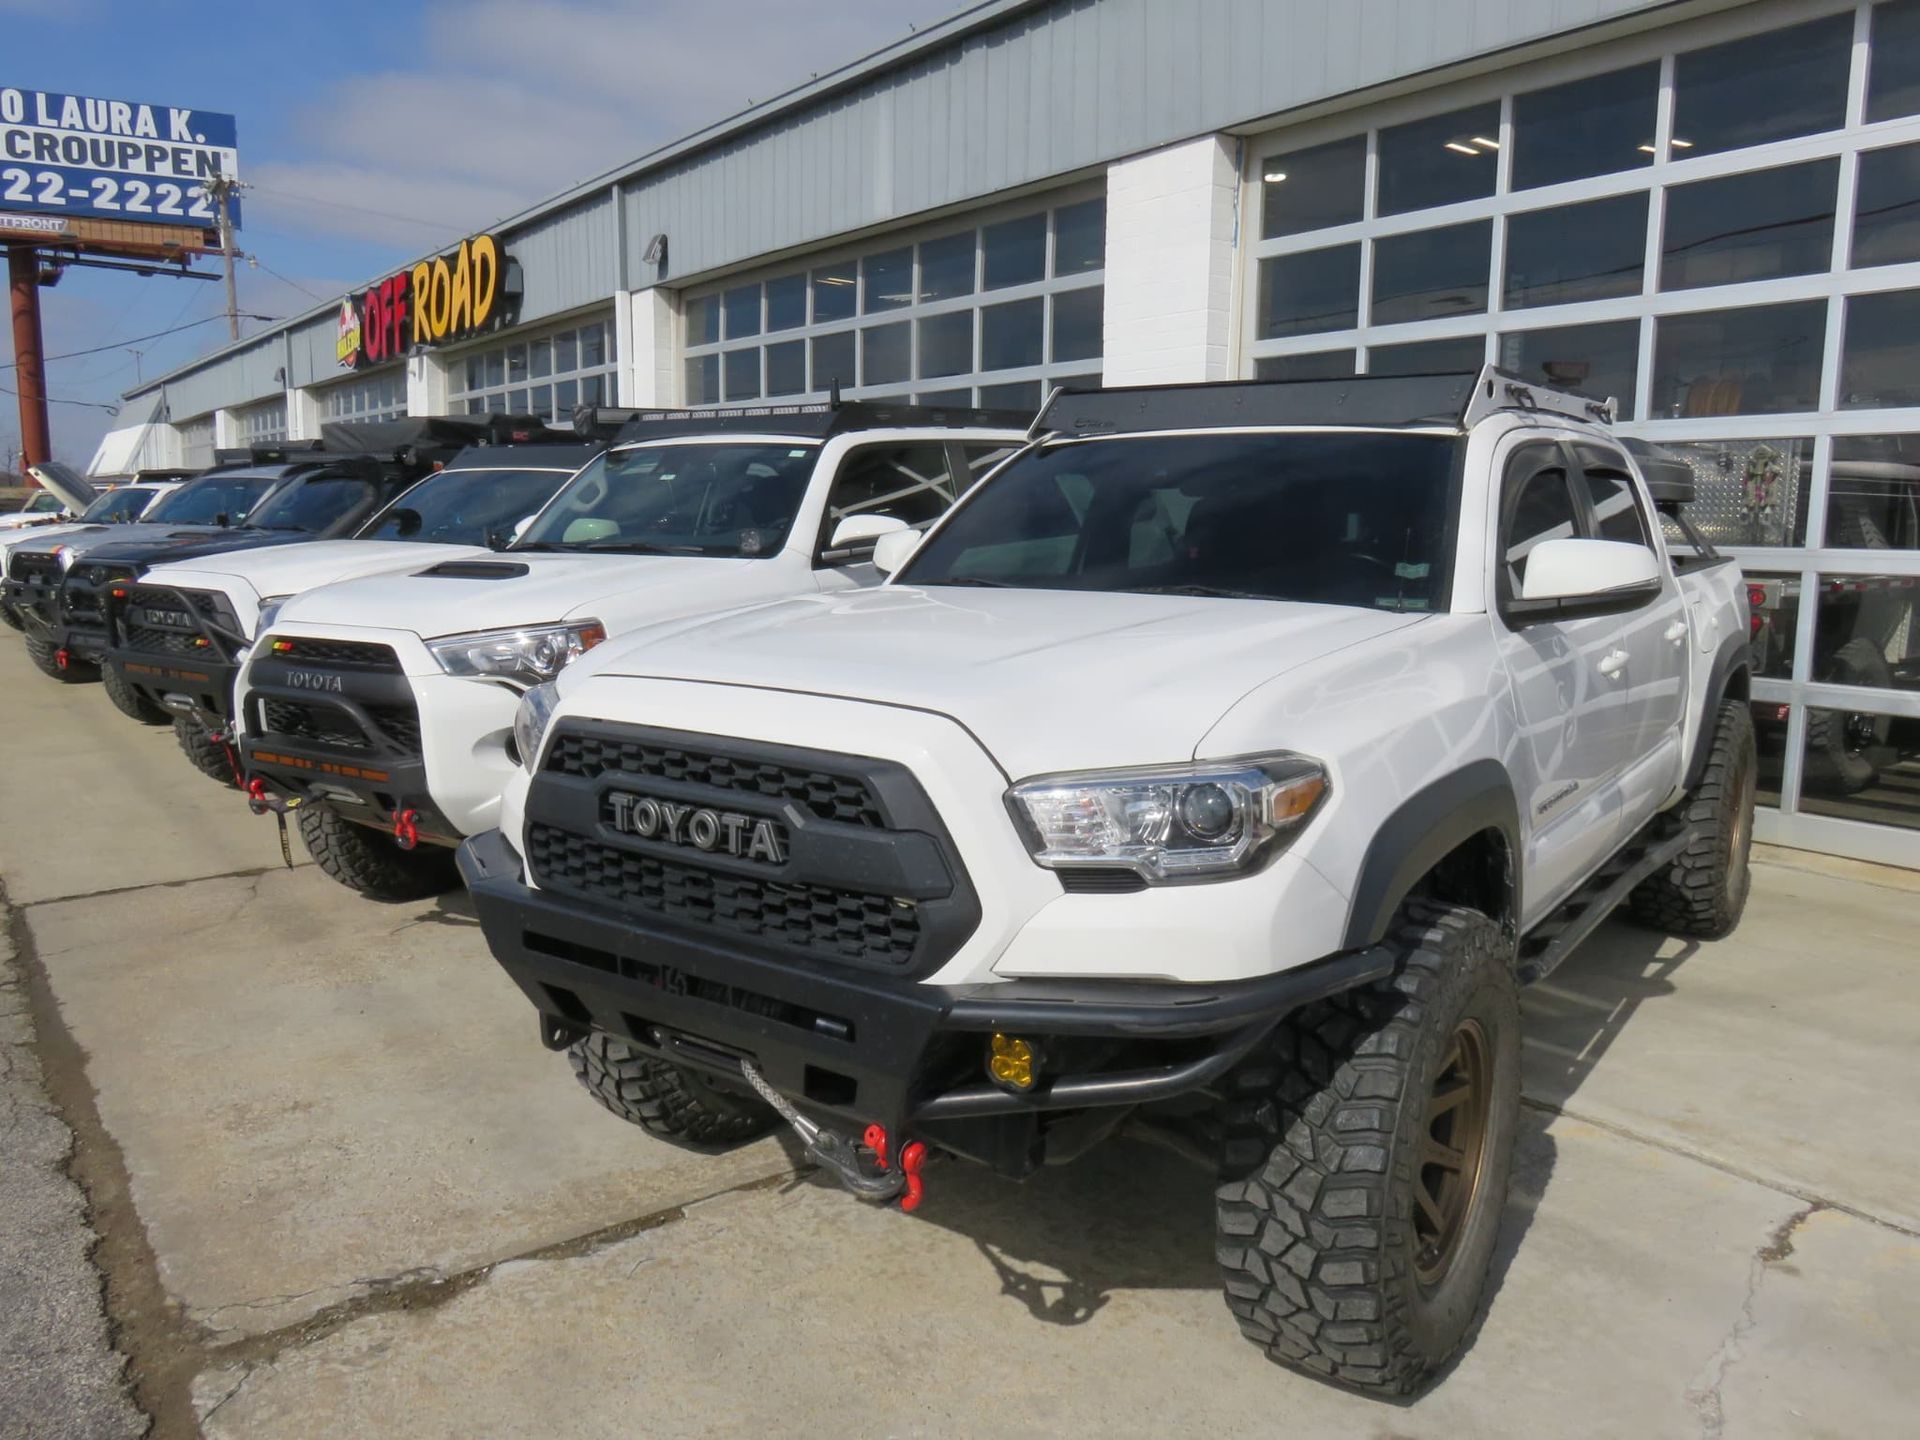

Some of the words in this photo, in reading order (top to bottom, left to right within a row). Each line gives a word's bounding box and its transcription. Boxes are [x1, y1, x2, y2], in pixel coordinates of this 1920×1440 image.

[36, 92, 158, 139] LAURA
[169, 108, 206, 144] K.
[5, 129, 222, 178] CROUPPEN
[2, 168, 214, 219] 22-2222
[364, 272, 408, 361] OFF
[413, 234, 496, 343] ROAD
[144, 609, 192, 627] TOYOTA
[286, 671, 343, 692] TOYOTA
[609, 793, 782, 863] TOYOTA
